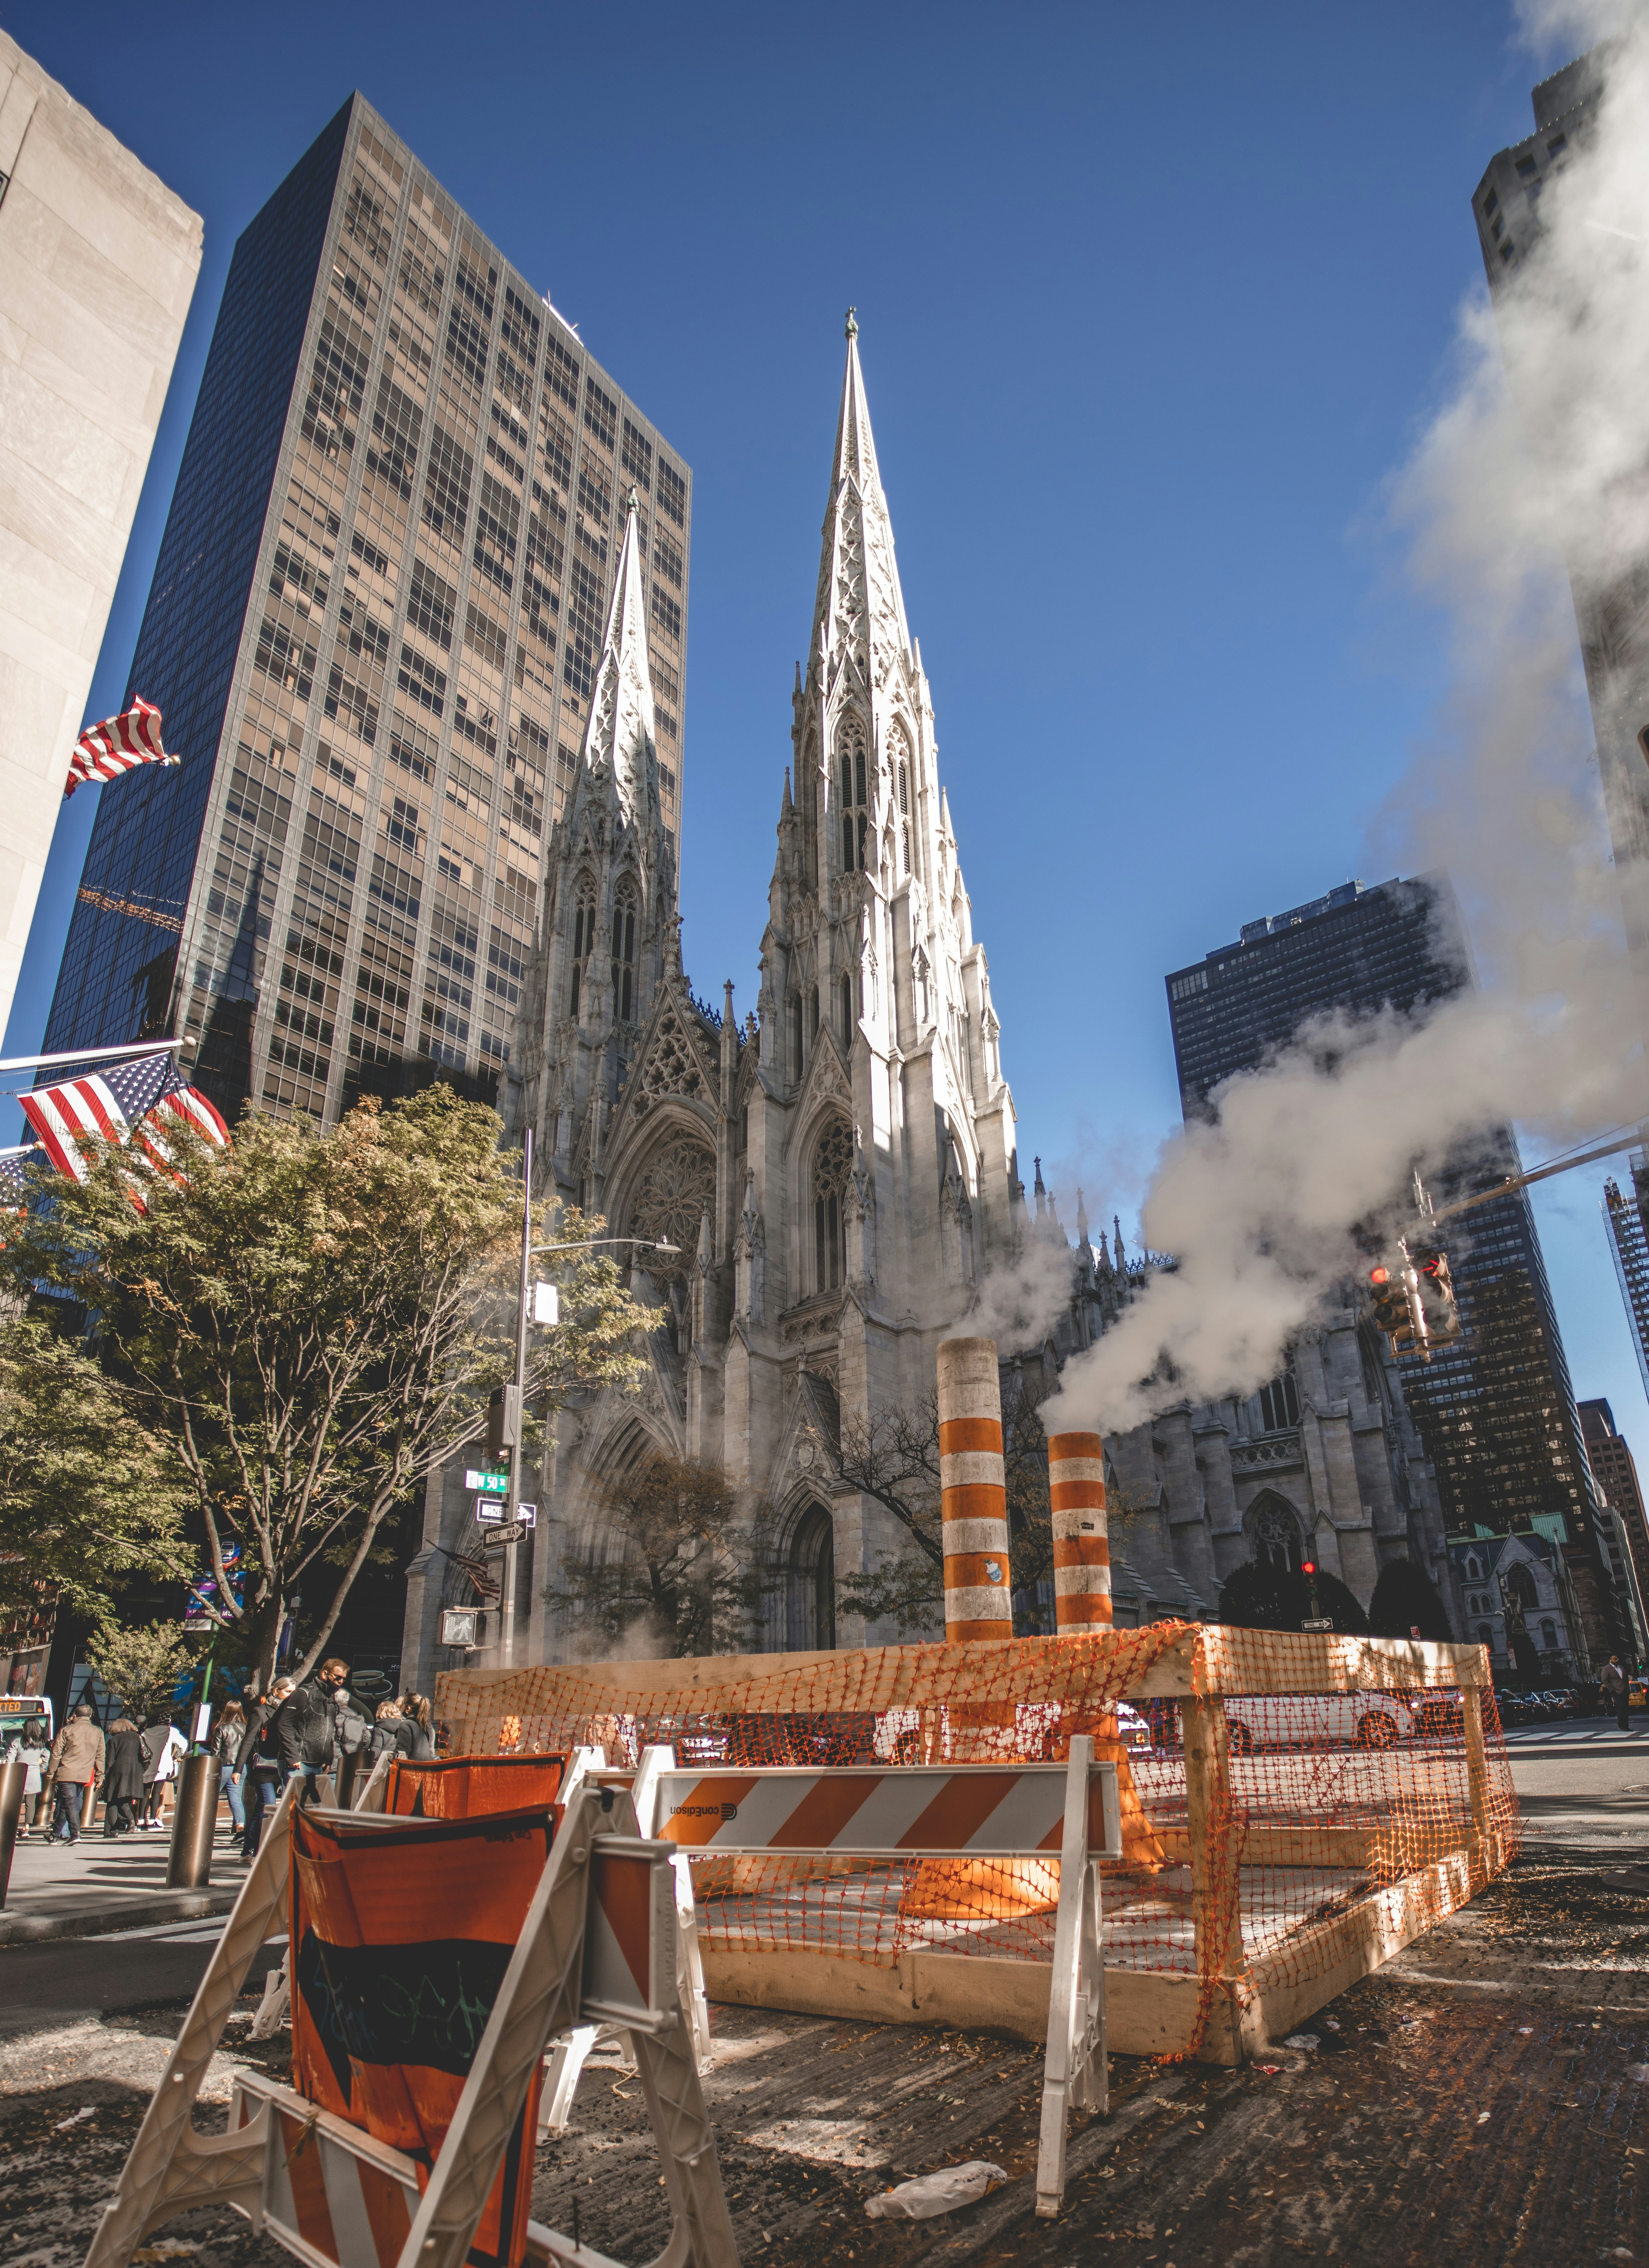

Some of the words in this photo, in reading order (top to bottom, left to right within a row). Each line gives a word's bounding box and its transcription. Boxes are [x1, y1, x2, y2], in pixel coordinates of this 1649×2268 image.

[478, 1474, 485, 1487] W
[487, 1476, 497, 1489] 50
[487, 1507, 503, 1516] ONE
[489, 1531, 501, 1542] ONE
[507, 1527, 520, 1537] WAY
[670, 1807, 719, 1817] conEdison
